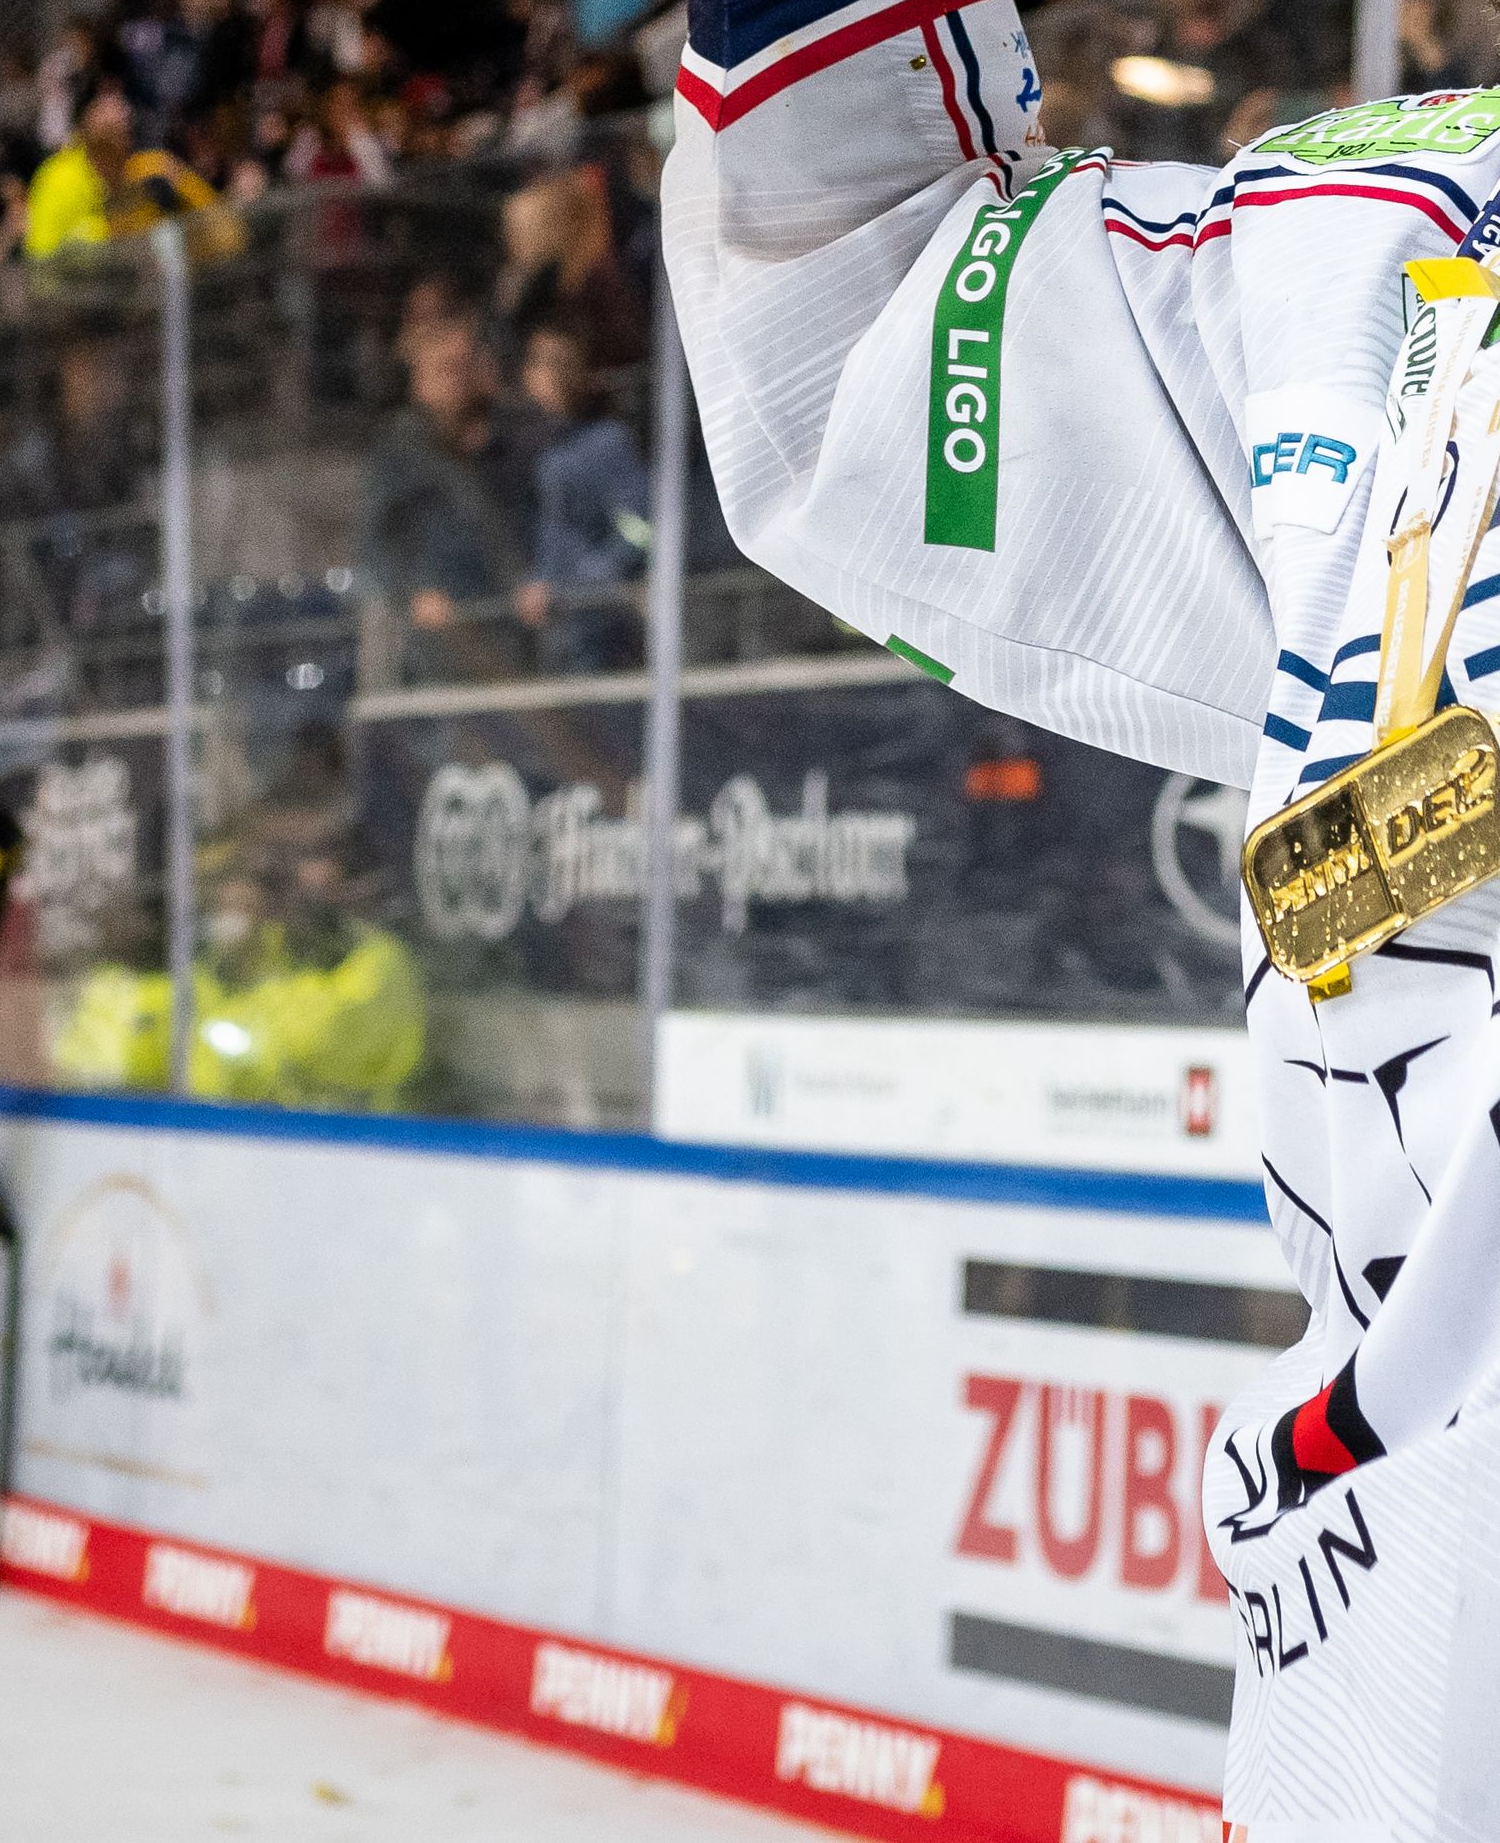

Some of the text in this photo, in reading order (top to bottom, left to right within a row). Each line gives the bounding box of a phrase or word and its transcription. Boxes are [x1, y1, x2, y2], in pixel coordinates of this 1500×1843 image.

[1273, 94, 1494, 146] Karls
[943, 329, 989, 474] LIGO
[1250, 432, 1357, 489] DER
[1225, 1487, 1378, 1679] RLIN
